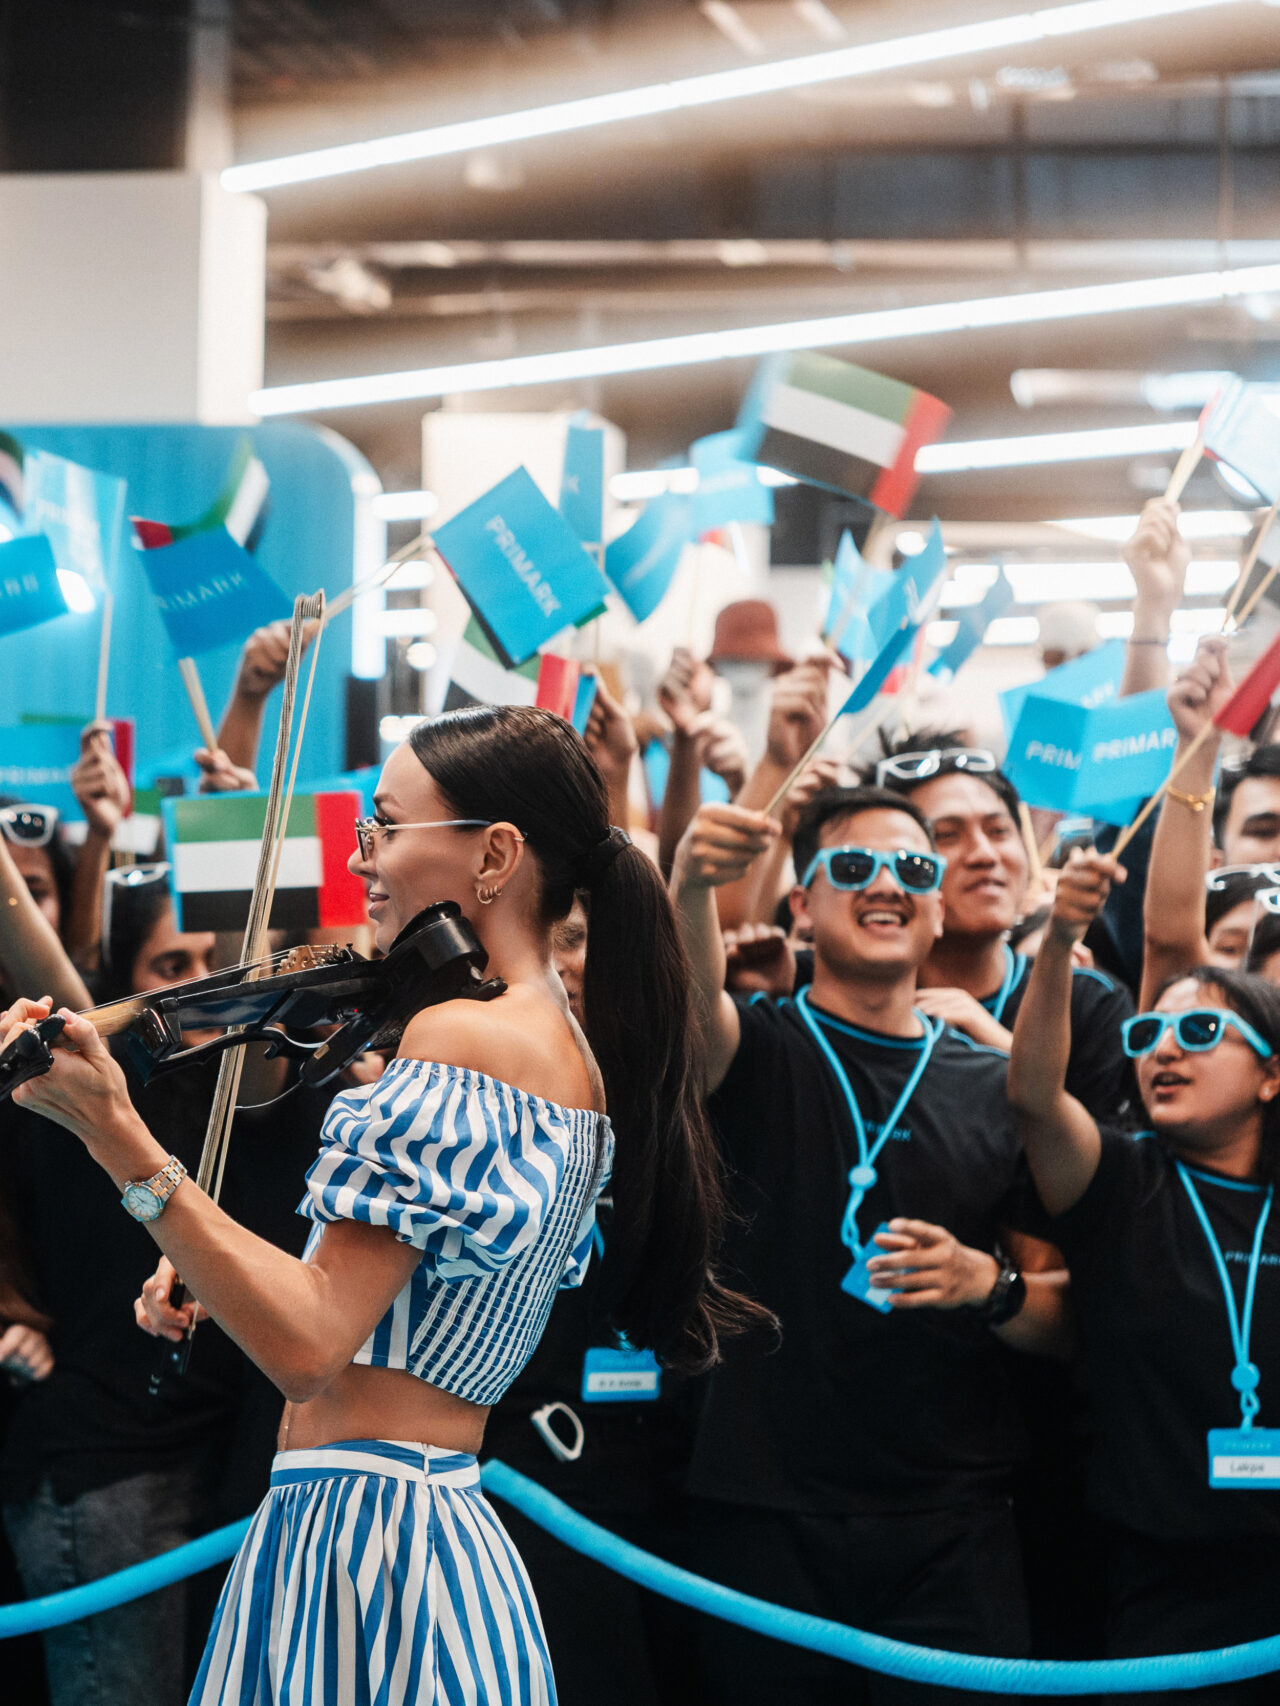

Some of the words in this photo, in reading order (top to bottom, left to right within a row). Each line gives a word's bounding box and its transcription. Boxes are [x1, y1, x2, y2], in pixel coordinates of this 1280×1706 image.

[486, 515, 561, 618] PRIMARK
[1025, 740, 1082, 770] PRIM
[1092, 727, 1176, 763] PRIMAR
